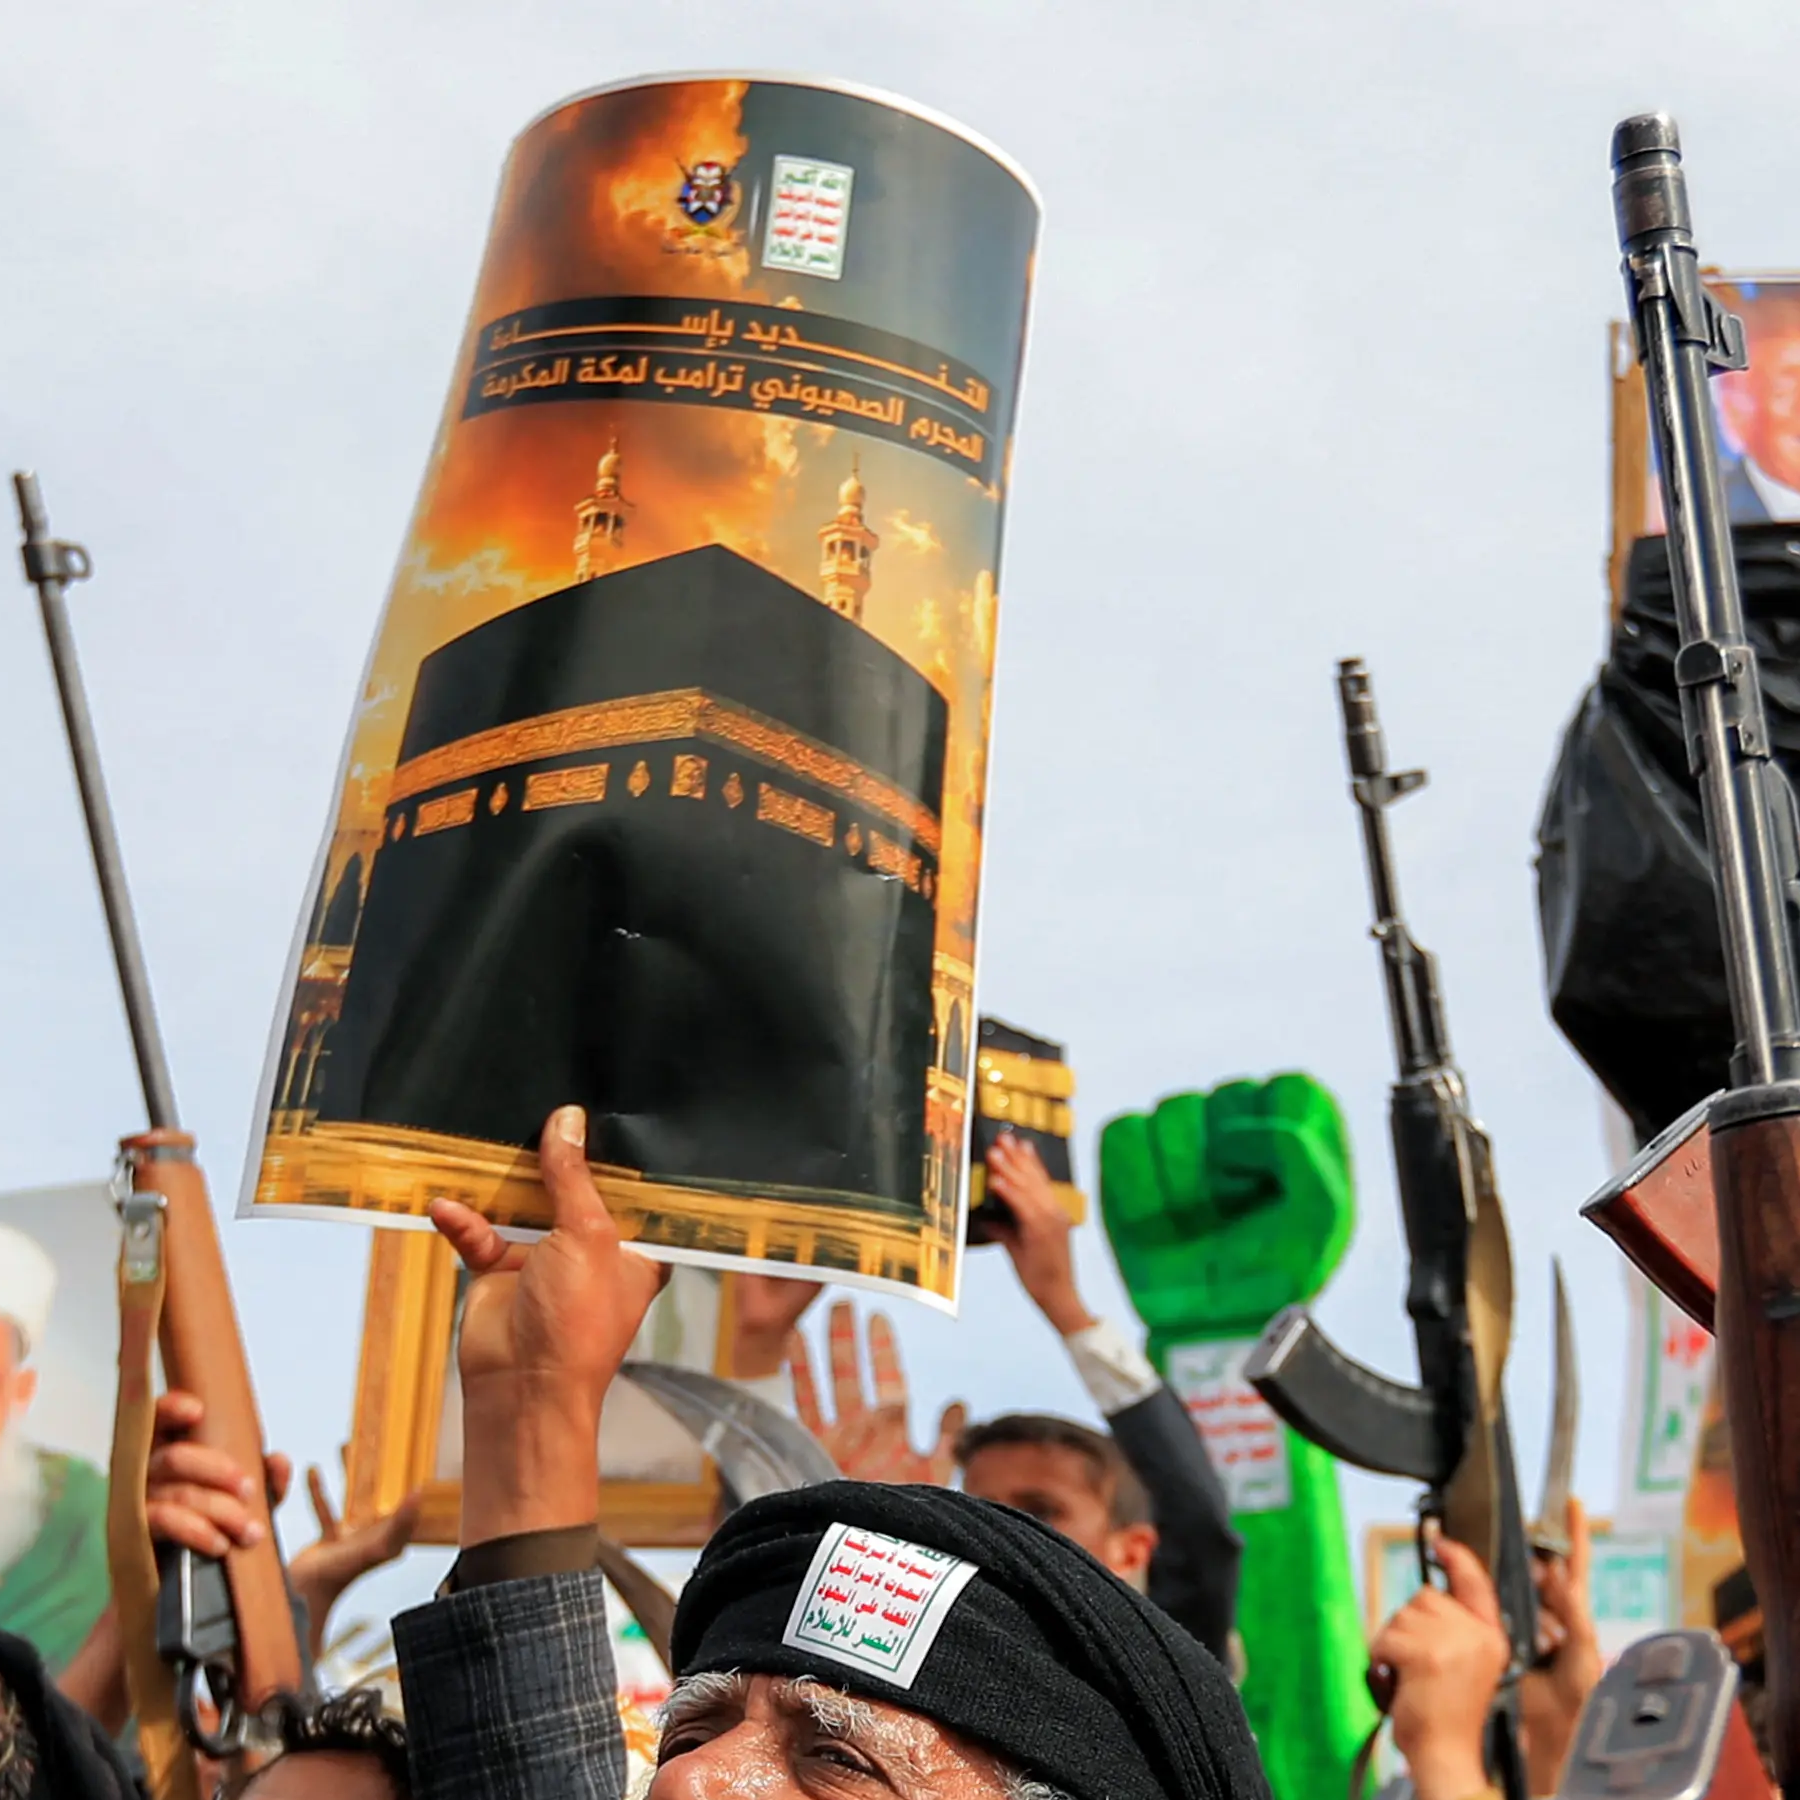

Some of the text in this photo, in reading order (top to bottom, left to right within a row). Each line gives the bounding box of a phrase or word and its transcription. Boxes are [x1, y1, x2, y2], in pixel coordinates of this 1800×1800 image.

[481, 355, 985, 463] المجرم الصهيوني ترامب لمكة المكرمة
[884, 1579, 930, 1604] الموت
[854, 1598, 879, 1614] على
[851, 1629, 905, 1657] النصر
